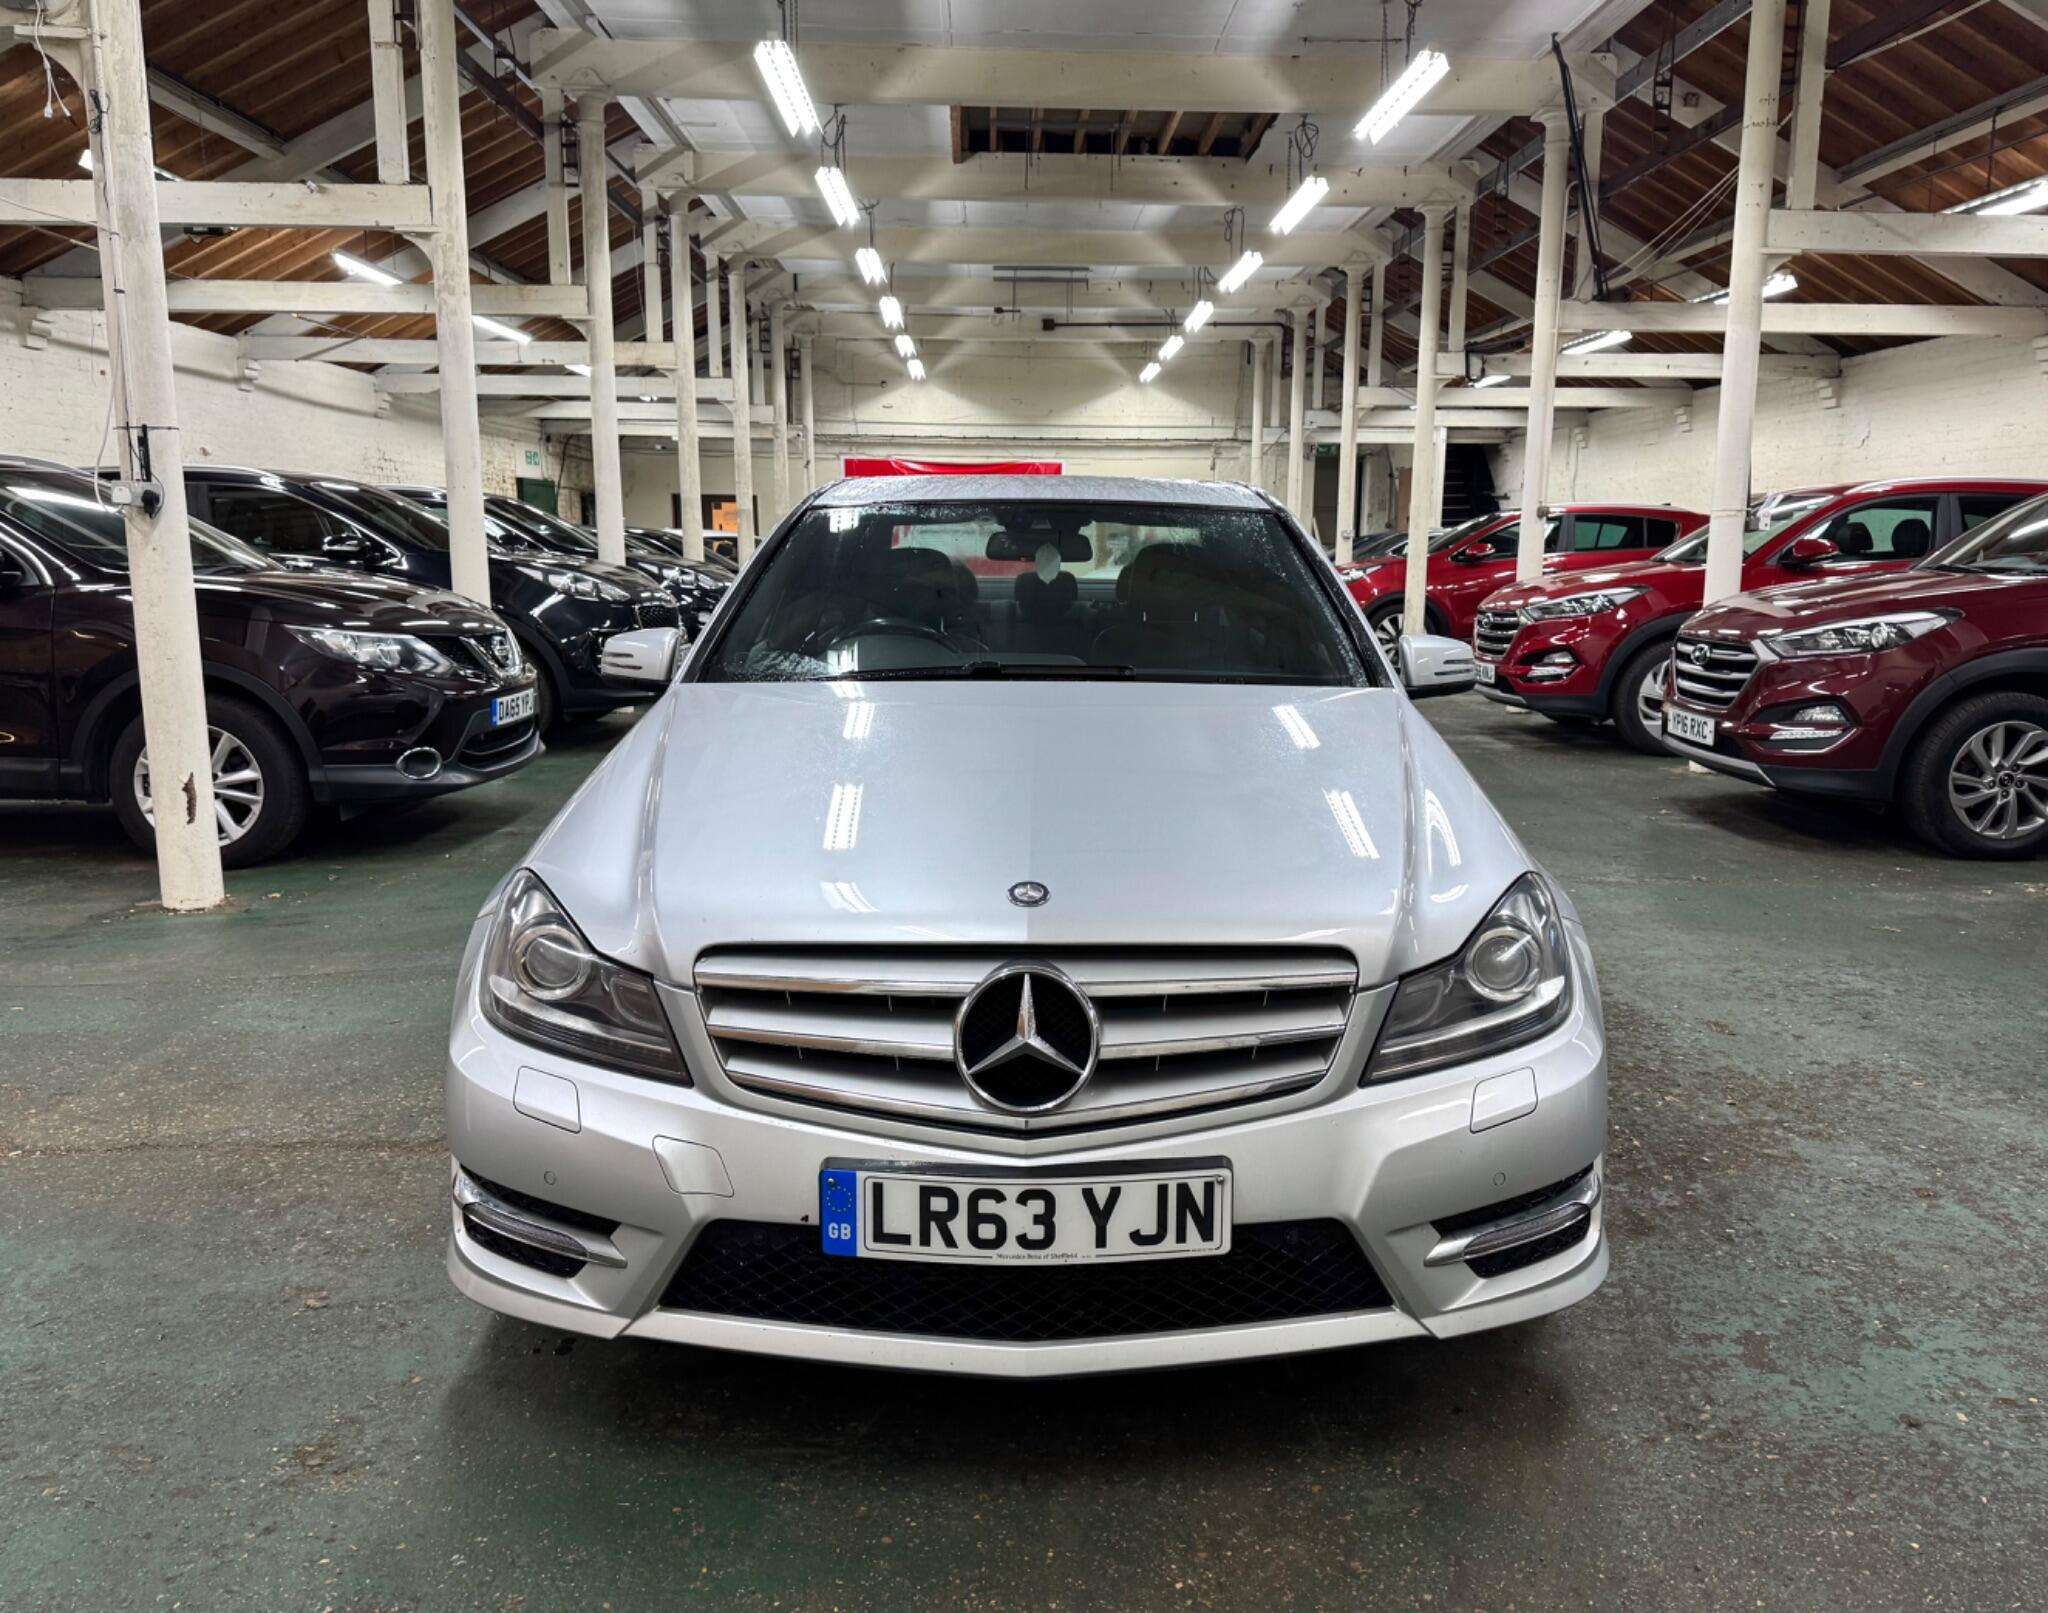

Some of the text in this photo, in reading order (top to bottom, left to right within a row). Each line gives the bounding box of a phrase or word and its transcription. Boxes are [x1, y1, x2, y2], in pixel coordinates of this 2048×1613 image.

[499, 696, 521, 720] DA65
[1672, 712, 1709, 739] YP16 RXC
[872, 1182, 1215, 1250] LR63 YJN
[828, 1222, 851, 1239] GB
